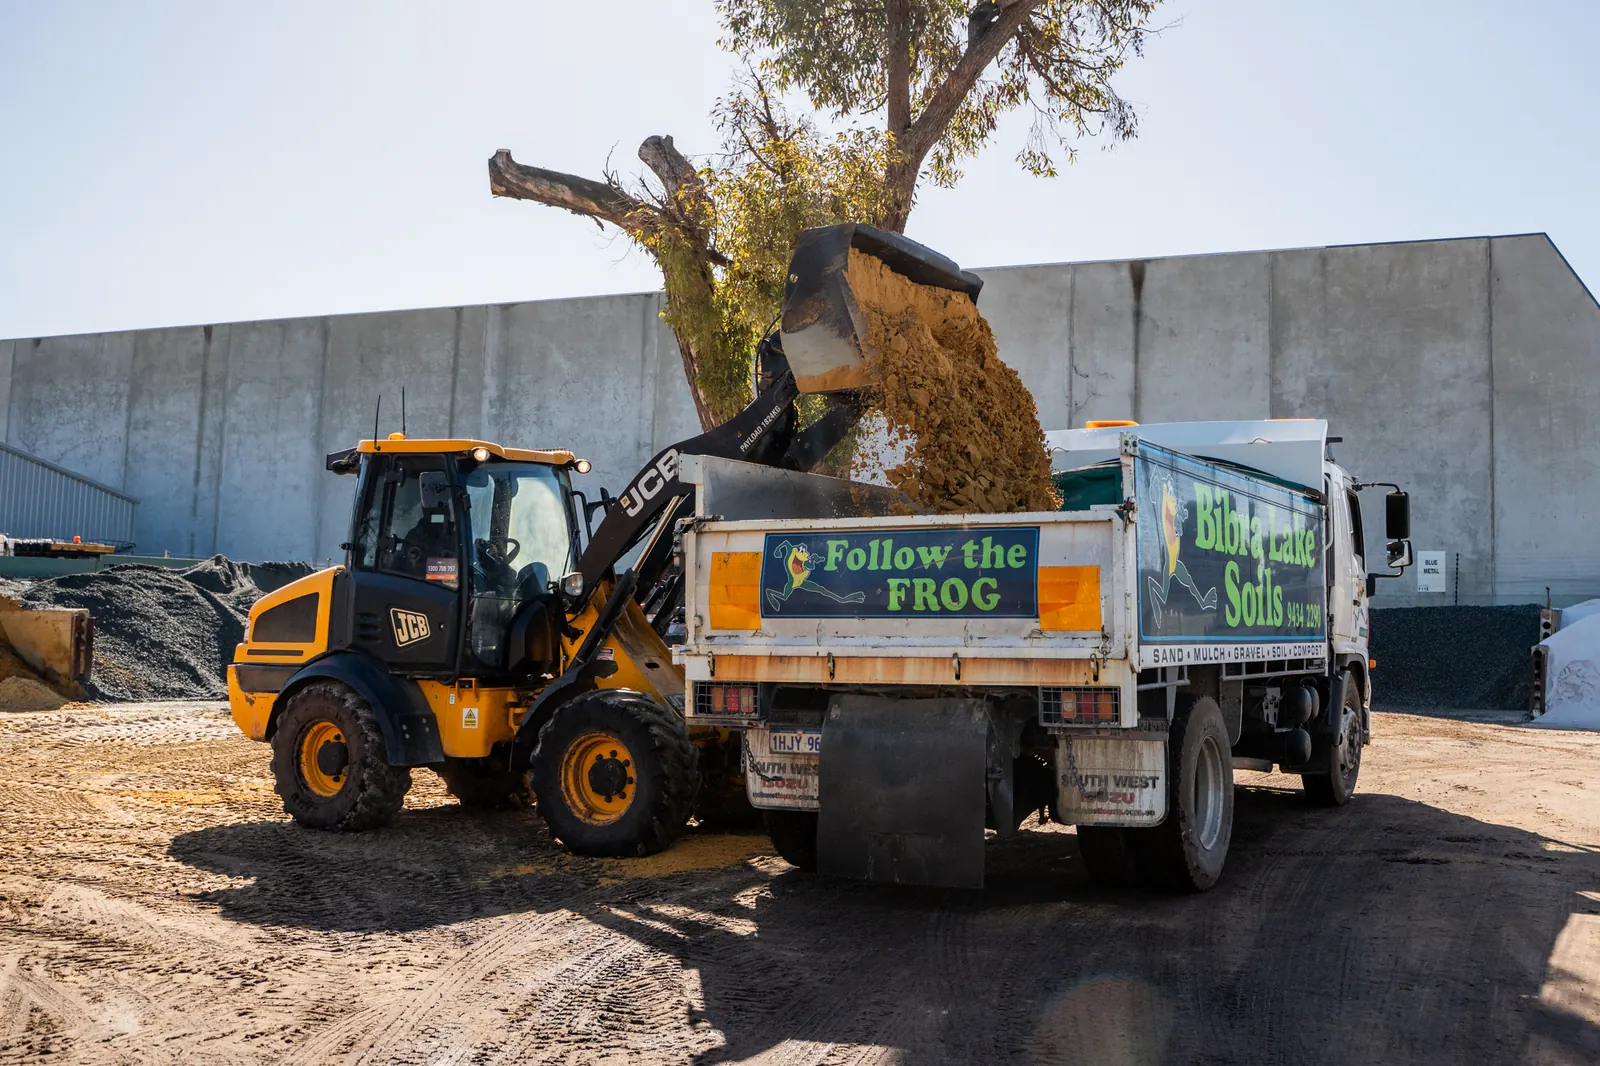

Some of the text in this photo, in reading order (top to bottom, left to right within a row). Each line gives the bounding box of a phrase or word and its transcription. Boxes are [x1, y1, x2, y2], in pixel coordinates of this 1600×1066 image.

[740, 405, 781, 452] PAYLOAD 1824KG
[1193, 481, 1316, 568] Bibra Lake
[824, 536, 1028, 571] Follow the
[886, 576, 1001, 612] FROG
[1224, 560, 1284, 628] Soils
[397, 612, 428, 642] JCB
[1287, 601, 1321, 628] 9434 2290
[1153, 645, 1322, 663] SAND MULCH GRAVEL SOIL COMPOST
[773, 735, 820, 752] 1HJY 96
[790, 762, 820, 776] WES
[1112, 775, 1160, 789] WEST
